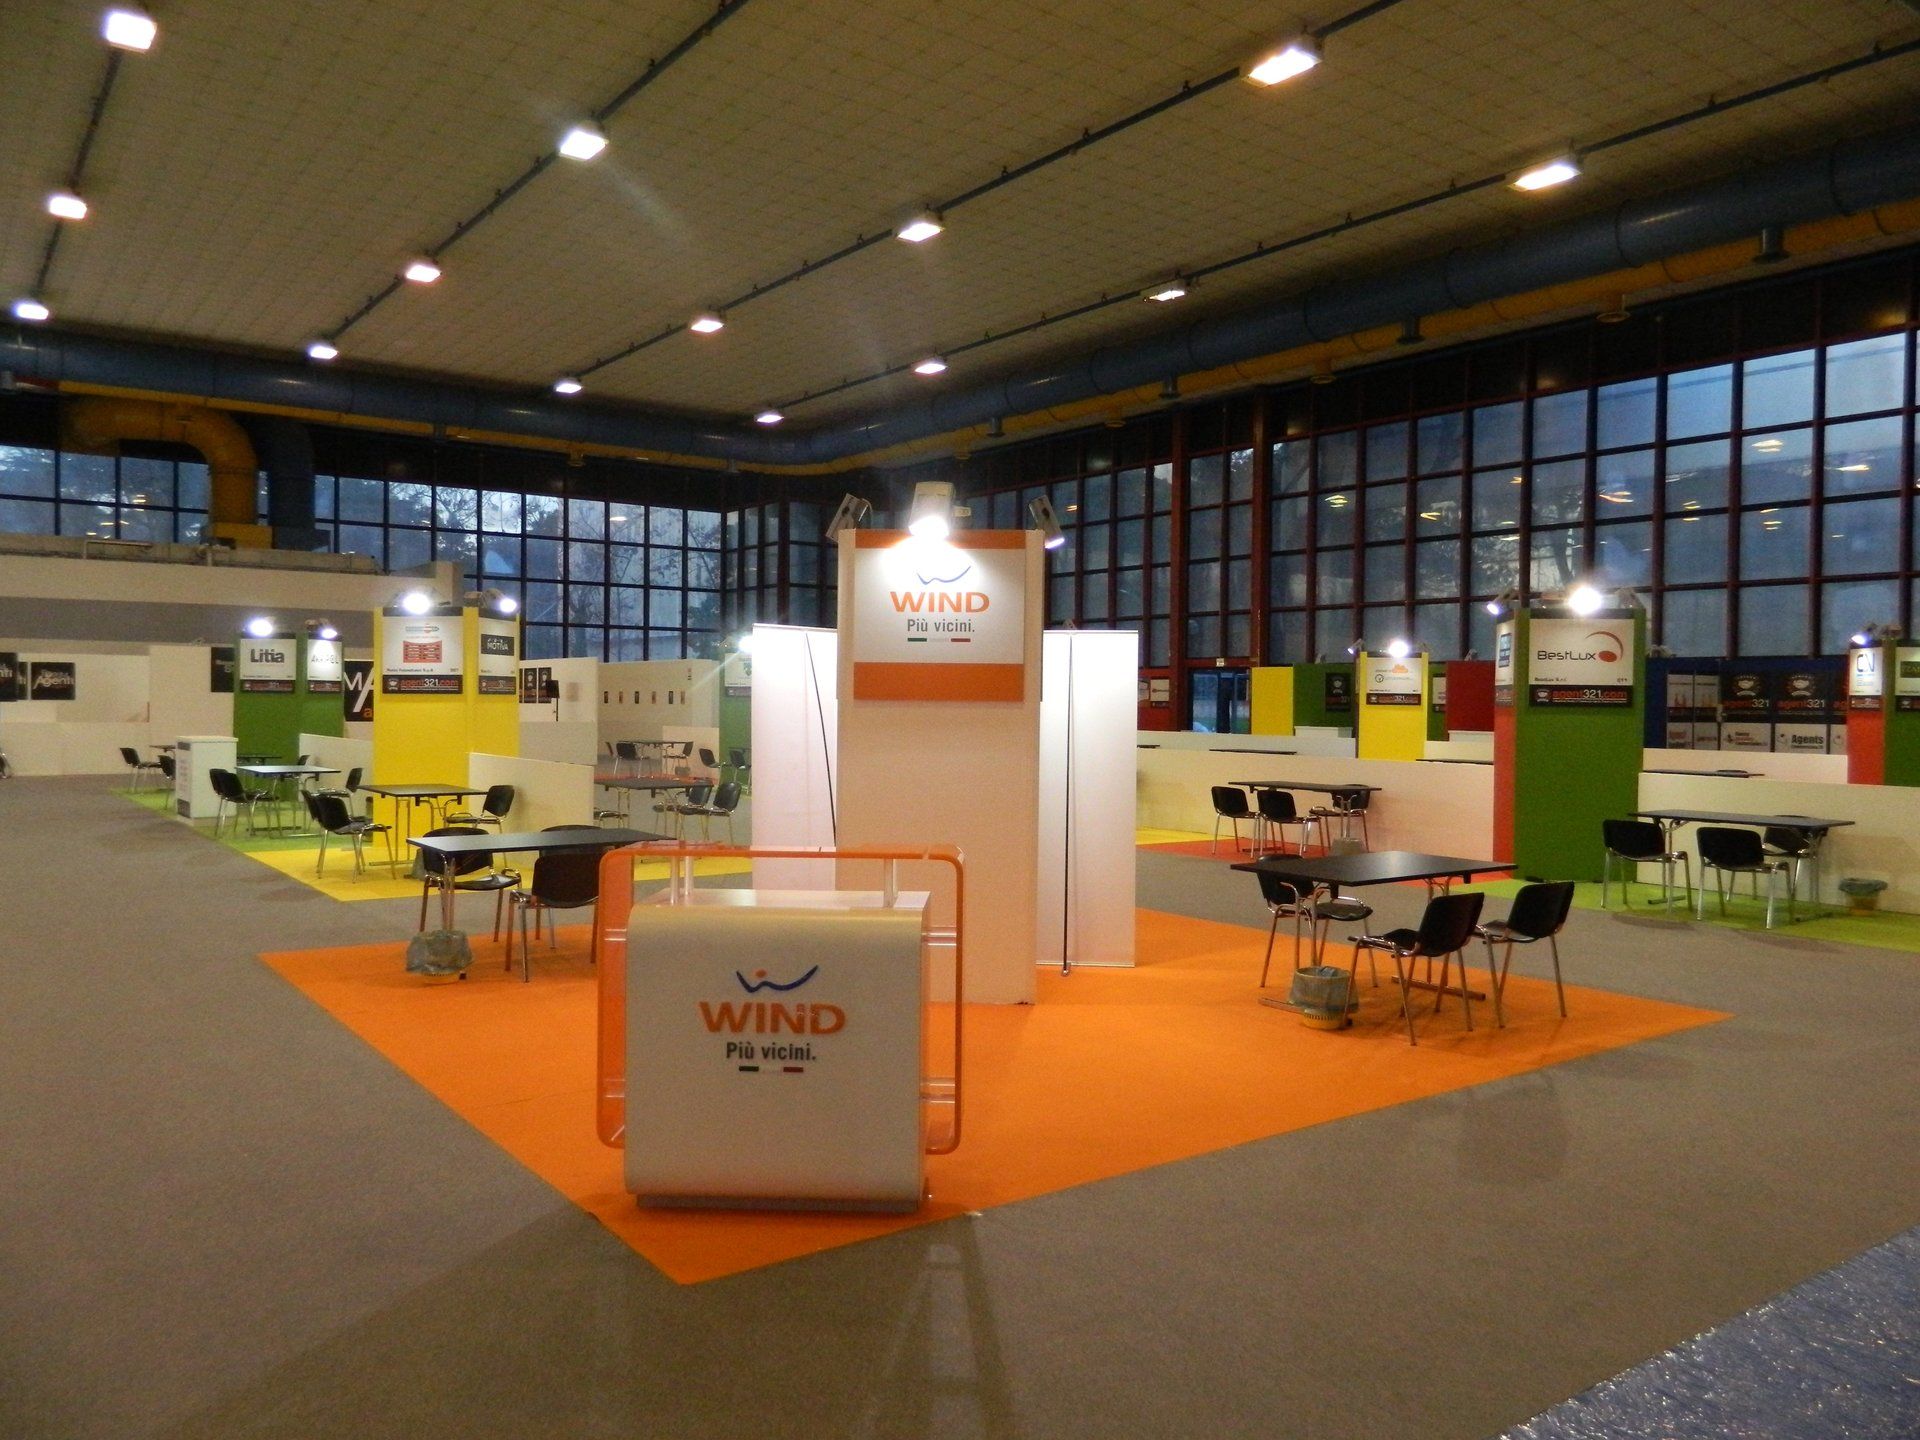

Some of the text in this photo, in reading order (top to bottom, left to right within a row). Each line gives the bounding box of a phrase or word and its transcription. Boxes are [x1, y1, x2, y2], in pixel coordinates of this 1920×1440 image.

[890, 591, 990, 613] WIND
[907, 618, 975, 633] Più vicini.
[250, 649, 285, 664] Litia
[1537, 650, 1597, 661] BestLux
[1552, 689, 1628, 700] agent321.com
[699, 1002, 846, 1035] WIND
[726, 1042, 816, 1061] Più vicini.
